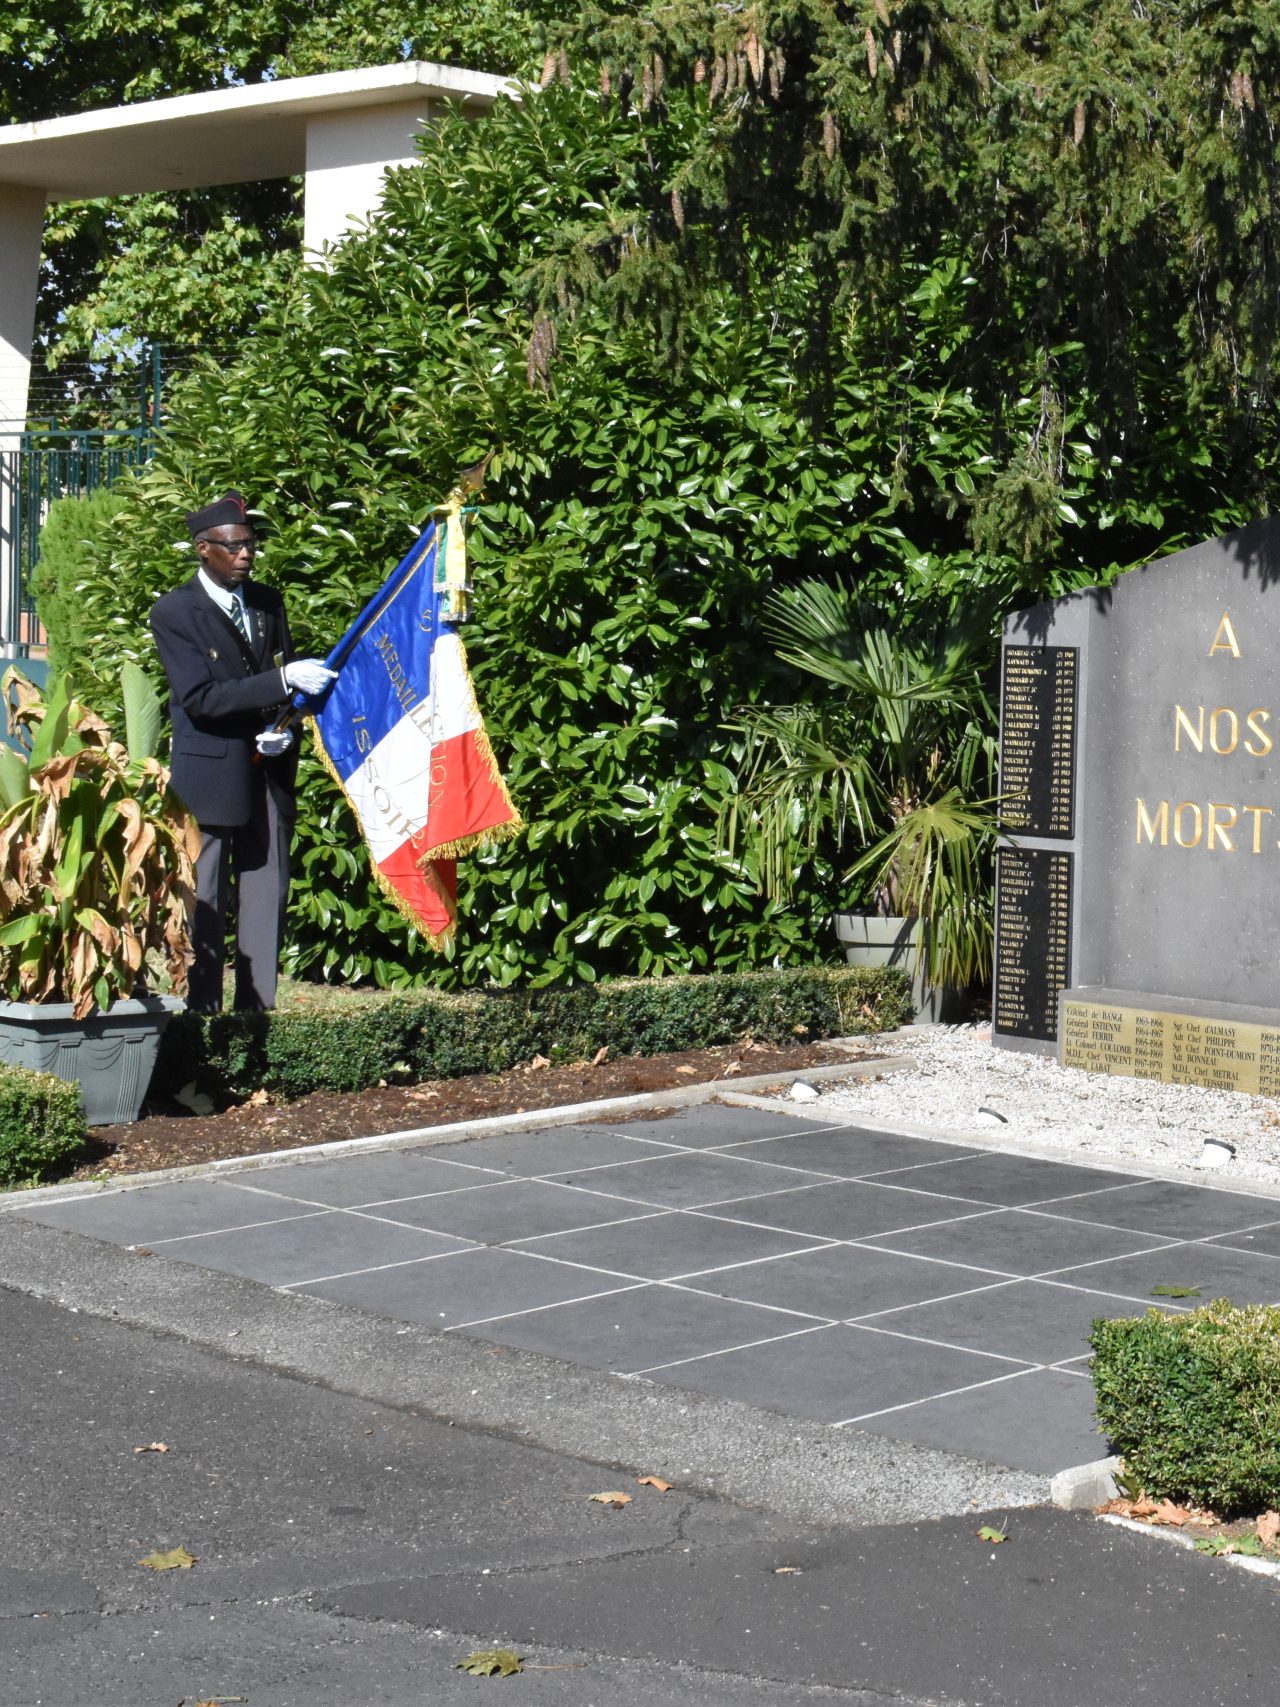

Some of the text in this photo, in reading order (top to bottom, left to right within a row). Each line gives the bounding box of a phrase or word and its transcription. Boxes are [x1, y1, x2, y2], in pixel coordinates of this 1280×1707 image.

[1208, 613, 1243, 657] A
[1174, 705, 1274, 756] NOS
[1066, 1007, 1088, 1018] Colonel
[1102, 1011, 1123, 1022] BANGE
[1066, 1017, 1122, 1032] Général ESTIENNE
[1174, 1022, 1182, 1031] Sgt
[1187, 1022, 1200, 1033] Chef
[1066, 1028, 1114, 1042] Général FERRIE
[1174, 1032, 1236, 1048] Adt Chef PHILIPPE
[1075, 1039, 1097, 1049] Colonel
[1100, 1043, 1132, 1054] COULOMB
[1173, 1042, 1256, 1062] Sgt Chef POINT-DUMONT
[1065, 1058, 1111, 1073] Général LABAT
[1087, 1051, 1100, 1061] Chef
[1104, 1054, 1132, 1065] VINCENT
[1173, 1053, 1218, 1066] Adt BONNEAU
[1184, 1076, 1198, 1086] Chef
[1194, 1066, 1208, 1076] Chef
[1213, 1070, 1240, 1081] METRAL
